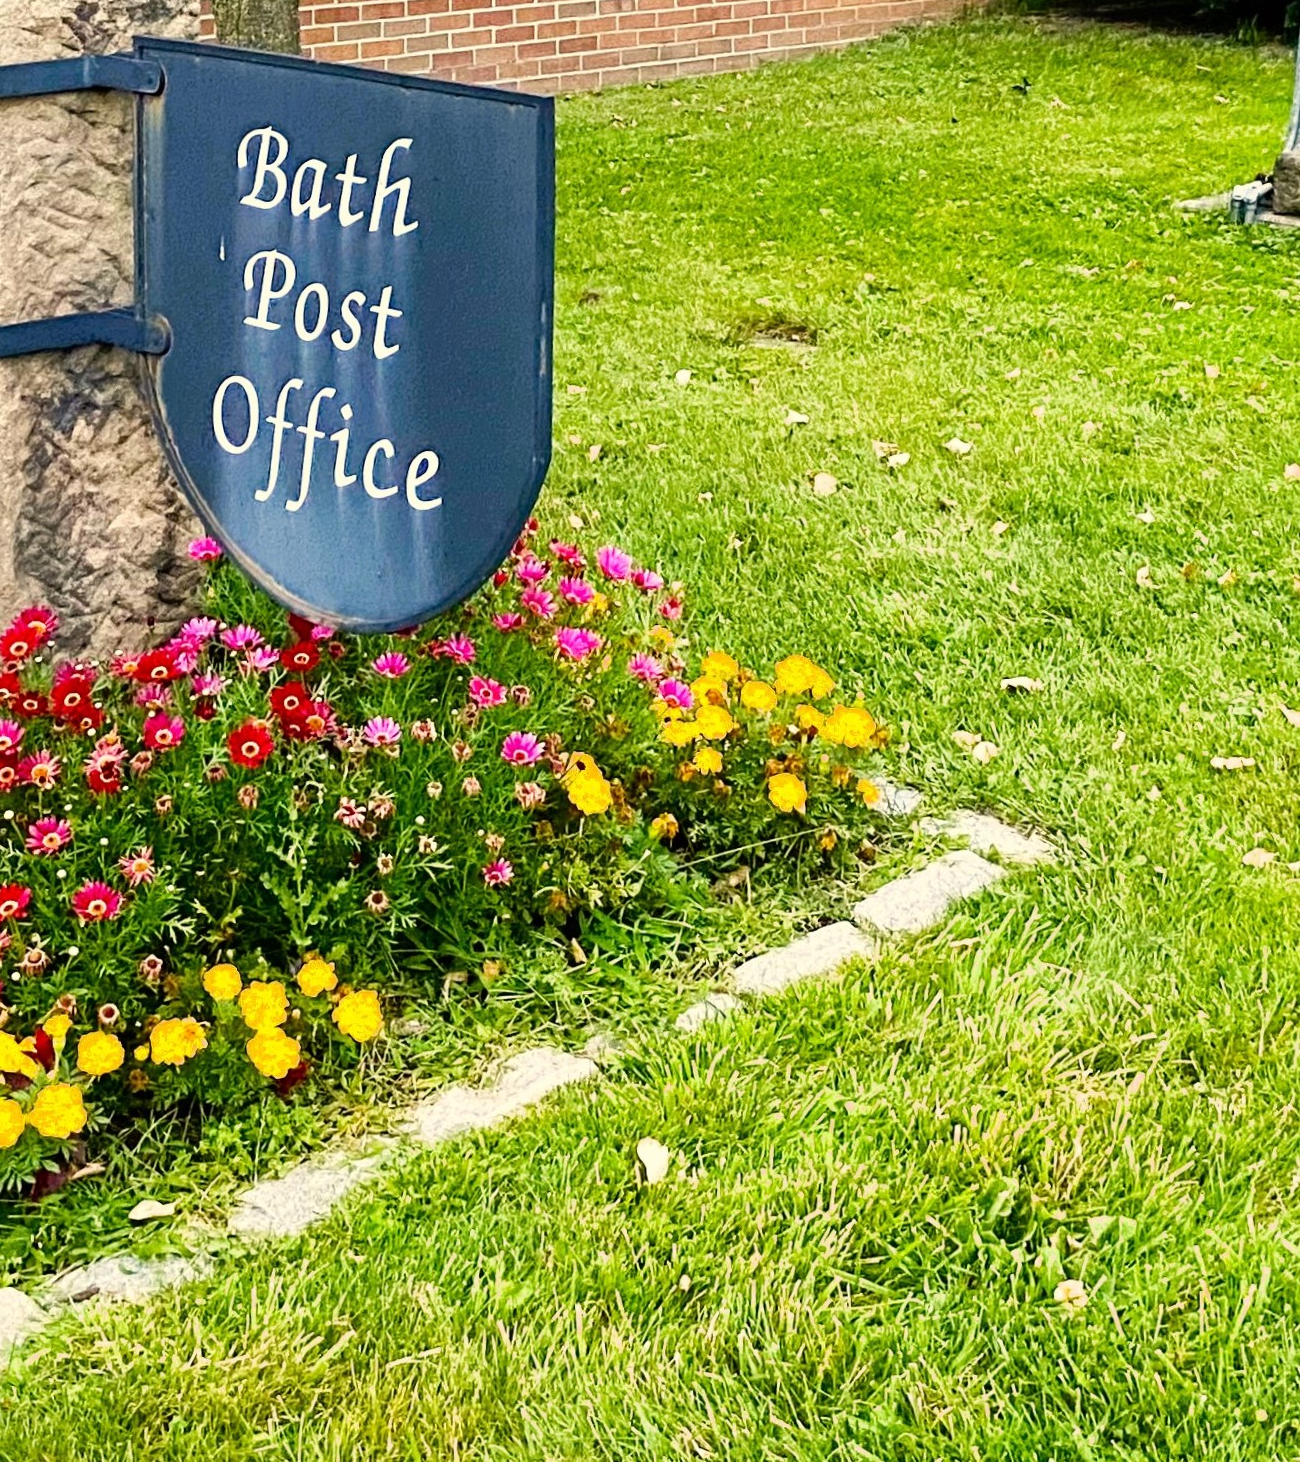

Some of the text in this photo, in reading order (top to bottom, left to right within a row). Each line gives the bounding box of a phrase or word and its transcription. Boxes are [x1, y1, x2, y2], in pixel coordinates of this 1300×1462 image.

[237, 125, 419, 237] Bath
[243, 248, 404, 360] Post
[212, 375, 443, 512] Office
